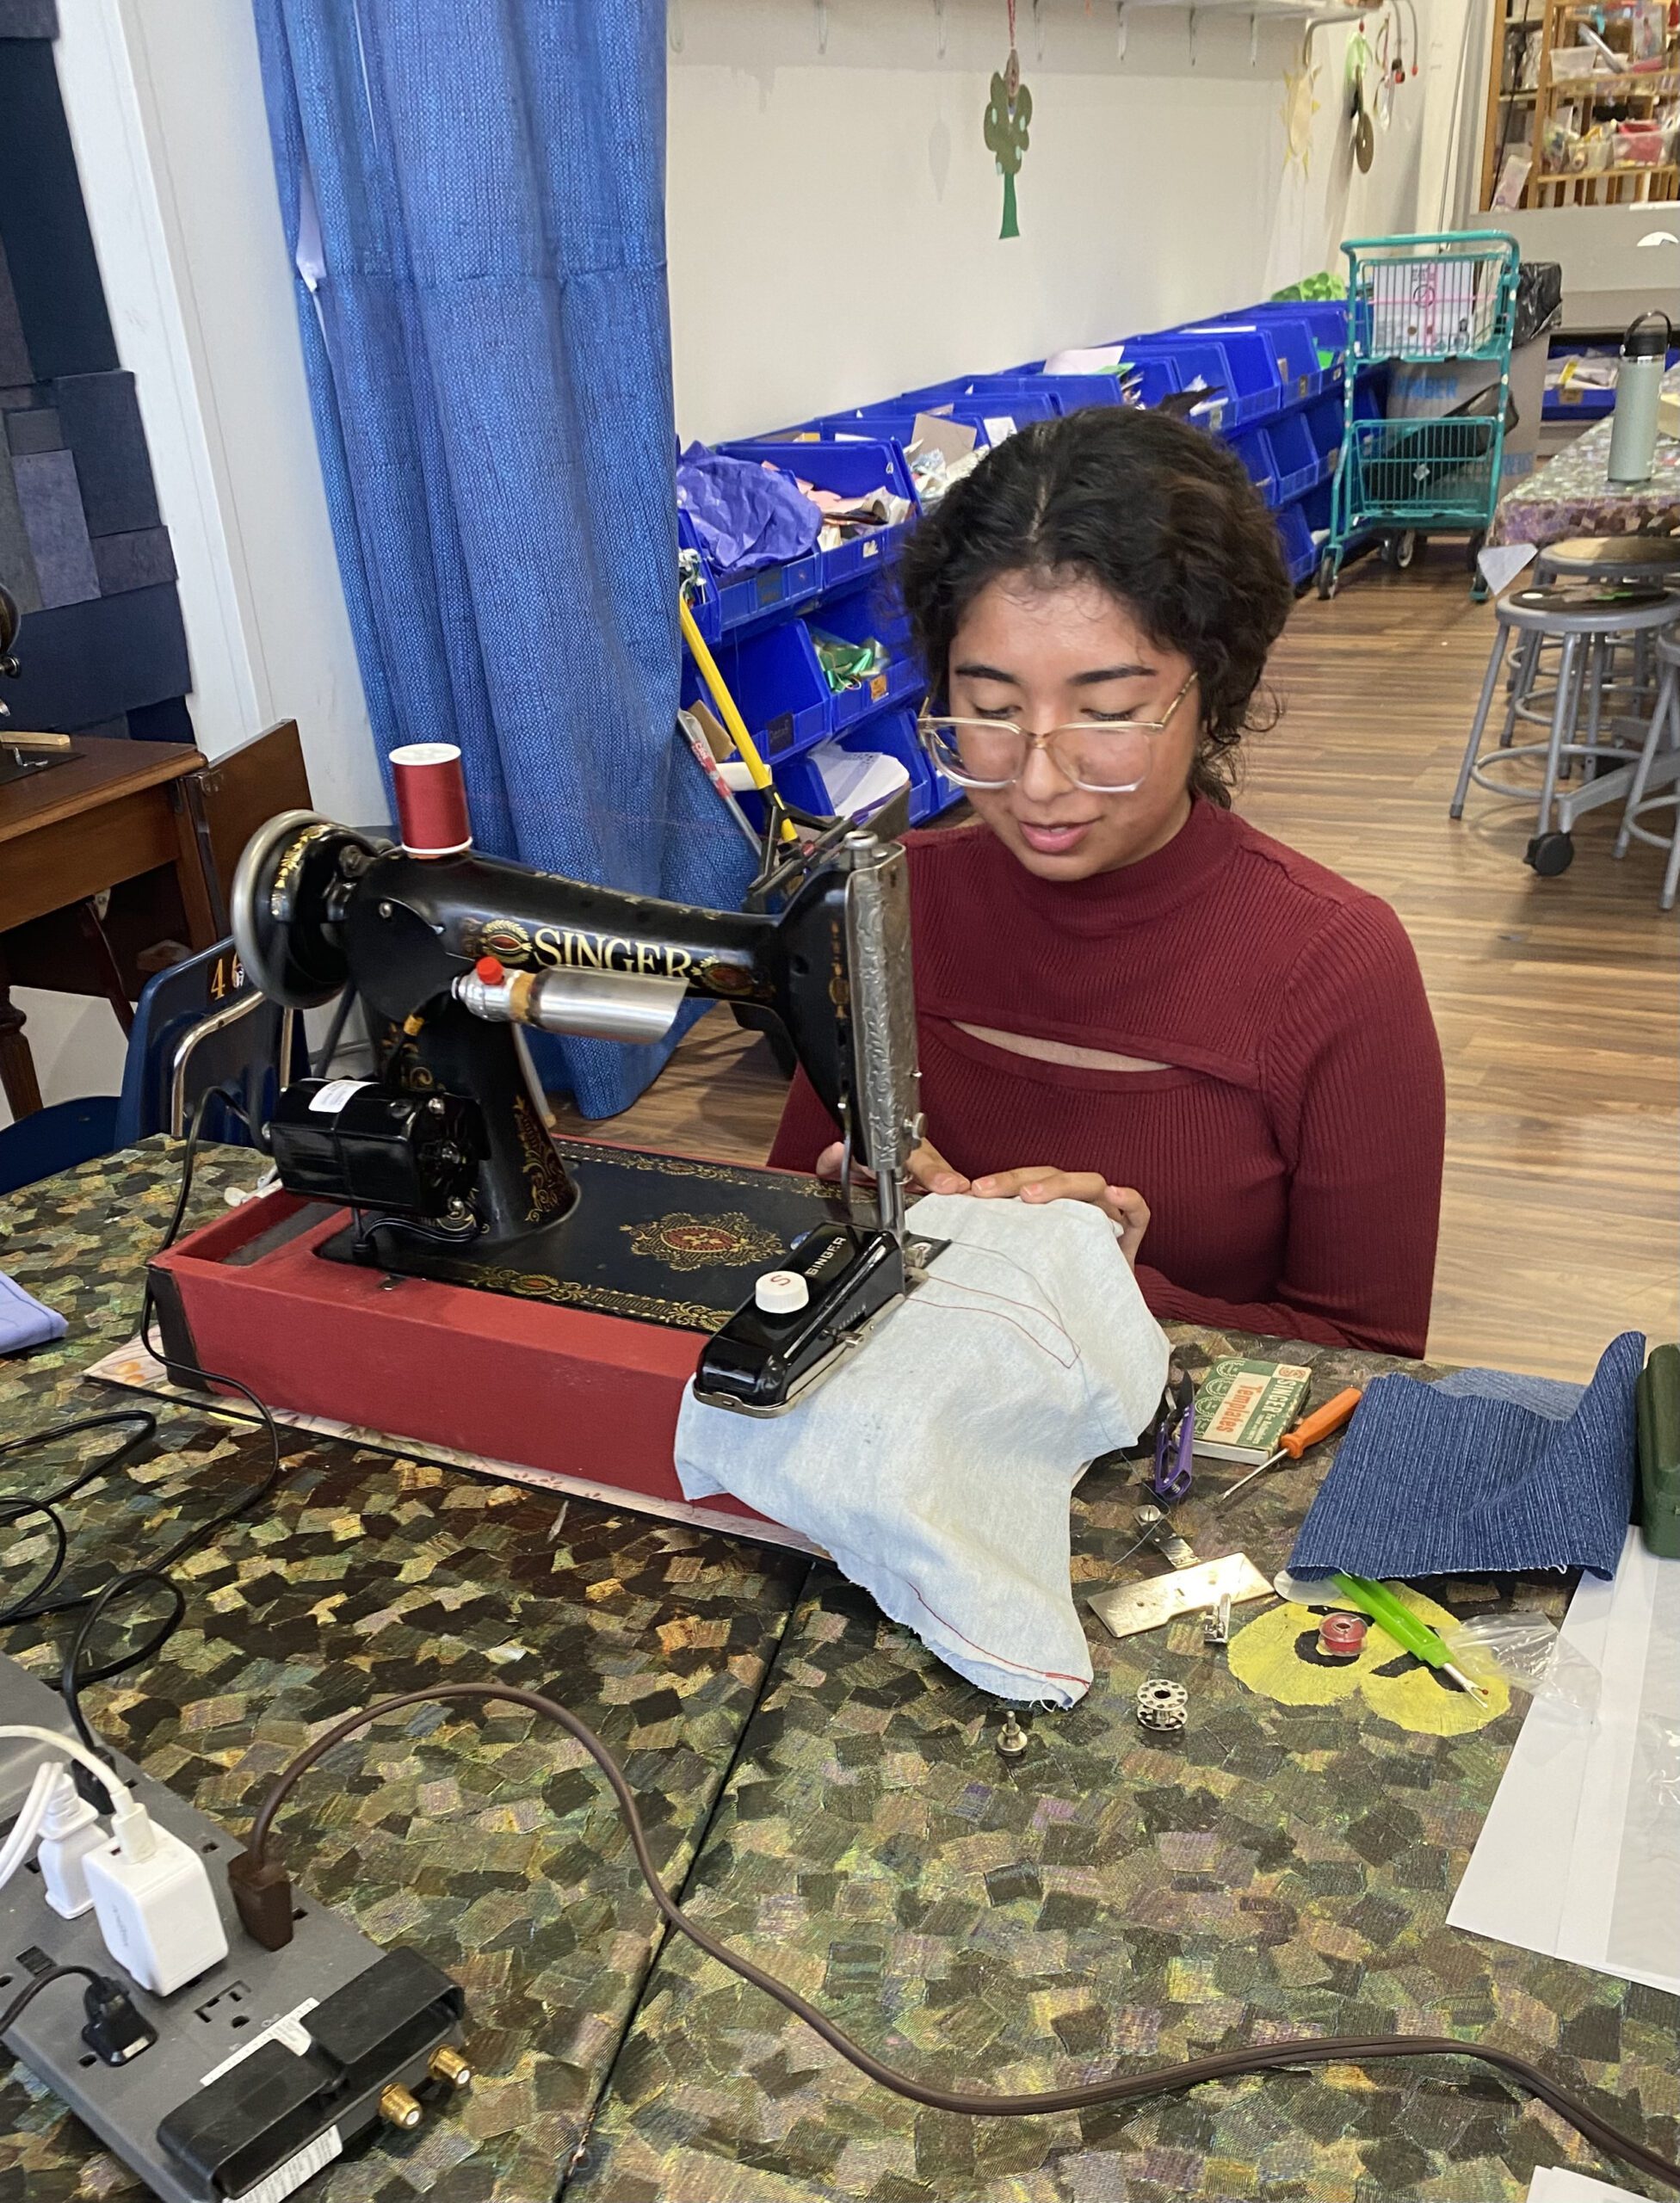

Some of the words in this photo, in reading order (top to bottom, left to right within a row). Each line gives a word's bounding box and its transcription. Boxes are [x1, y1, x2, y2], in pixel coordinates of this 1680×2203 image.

[534, 928, 692, 978] SINGER
[805, 1237, 846, 1275] SINGER
[770, 1274, 791, 1287] S
[1216, 1385, 1263, 1433] Templates
[1262, 1379, 1297, 1415] SINGER
